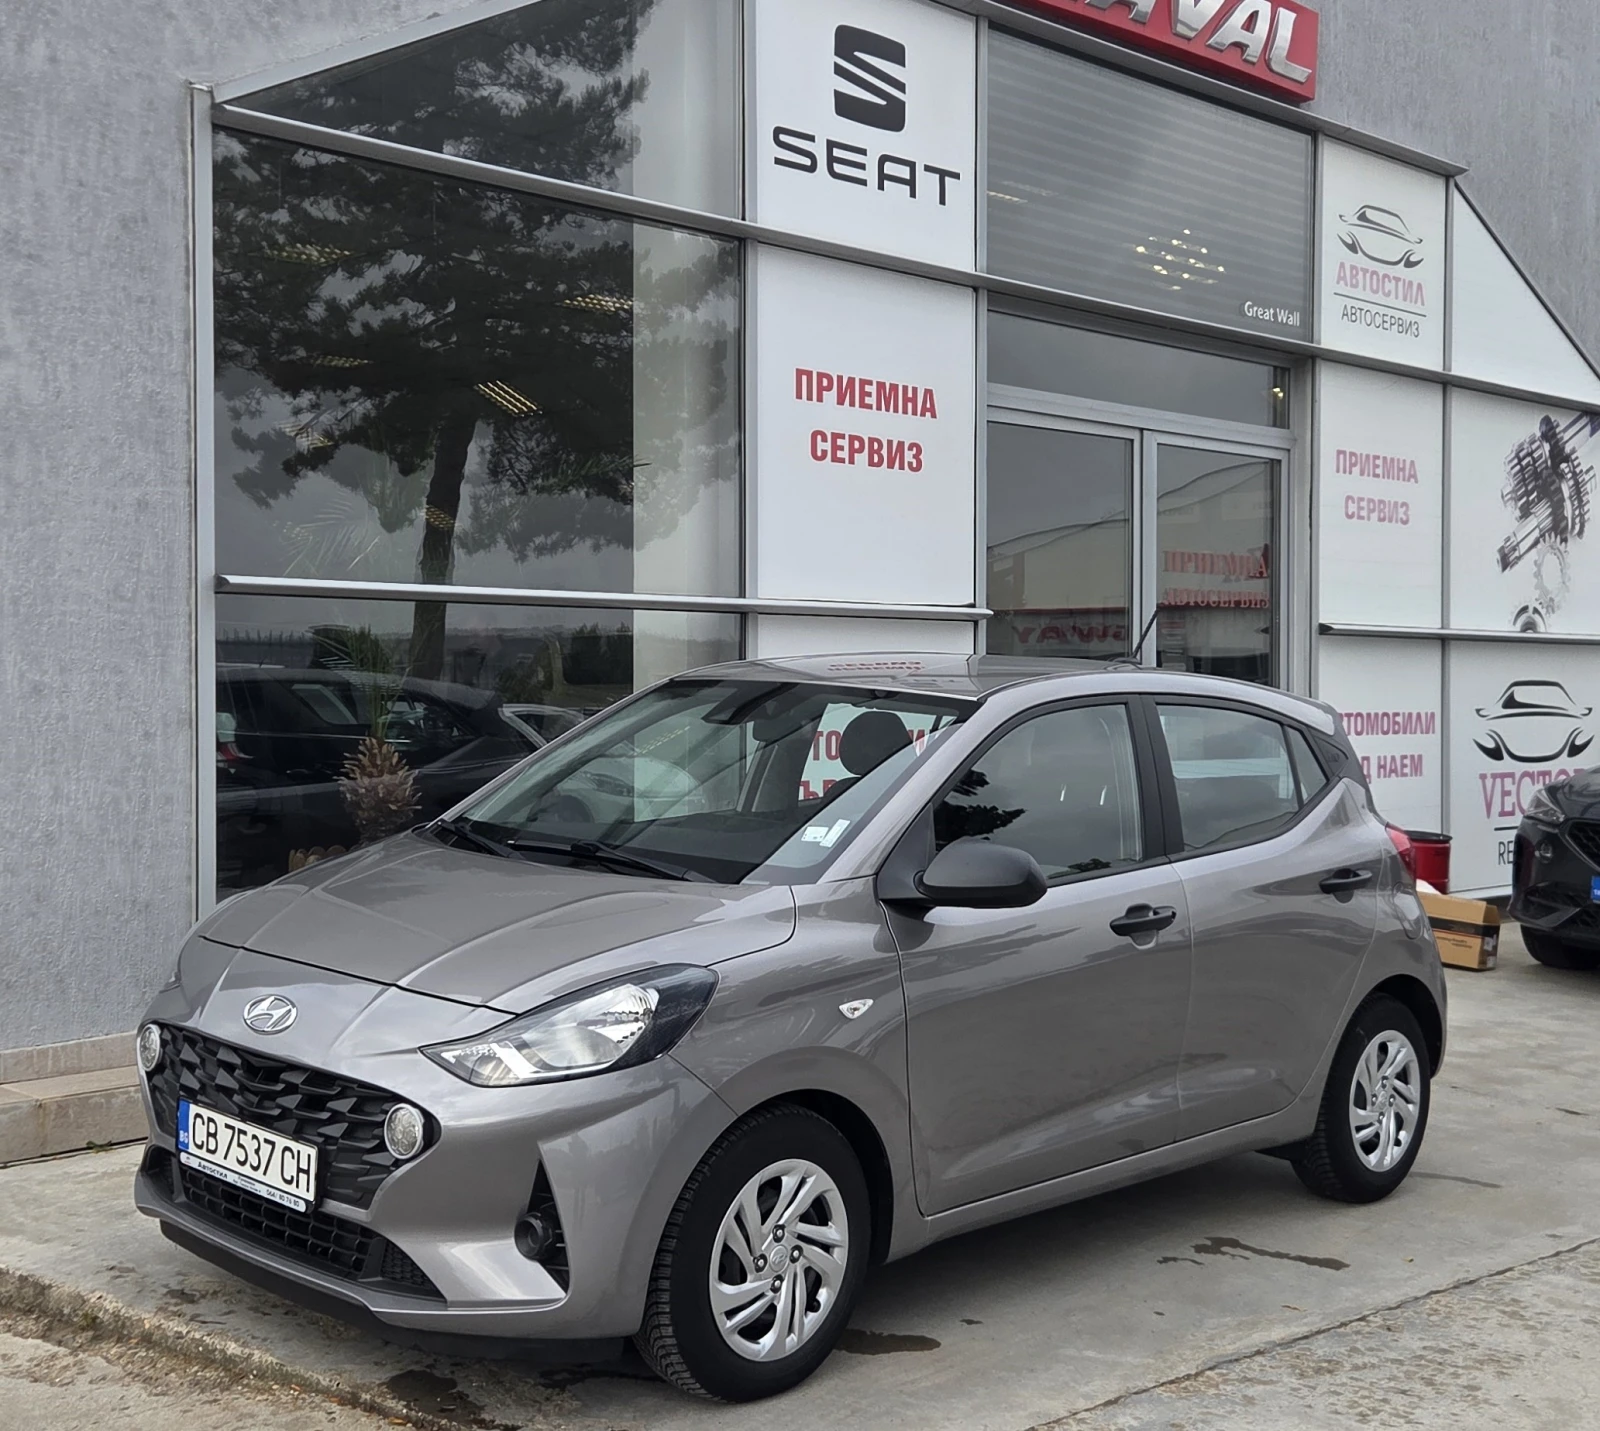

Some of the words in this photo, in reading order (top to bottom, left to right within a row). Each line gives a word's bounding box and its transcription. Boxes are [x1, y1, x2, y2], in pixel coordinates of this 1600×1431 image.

[773, 126, 960, 206] SEAT
[1336, 261, 1425, 307] АВТОСТИЛ
[1244, 300, 1275, 321] Great
[1276, 307, 1300, 327] Wall
[1341, 304, 1420, 338] АВТОСЕРВИЗ
[795, 367, 938, 419] ПРИЕМНА
[810, 429, 923, 473] СЕРВИЗ
[1335, 449, 1419, 484] ПРИЕМНА
[1344, 495, 1410, 525] СЕРВИЗ
[1376, 753, 1424, 779] НАЕМ
[193, 1112, 218, 1155] CB
[224, 1122, 276, 1176] 7537
[281, 1146, 311, 1193] CH
